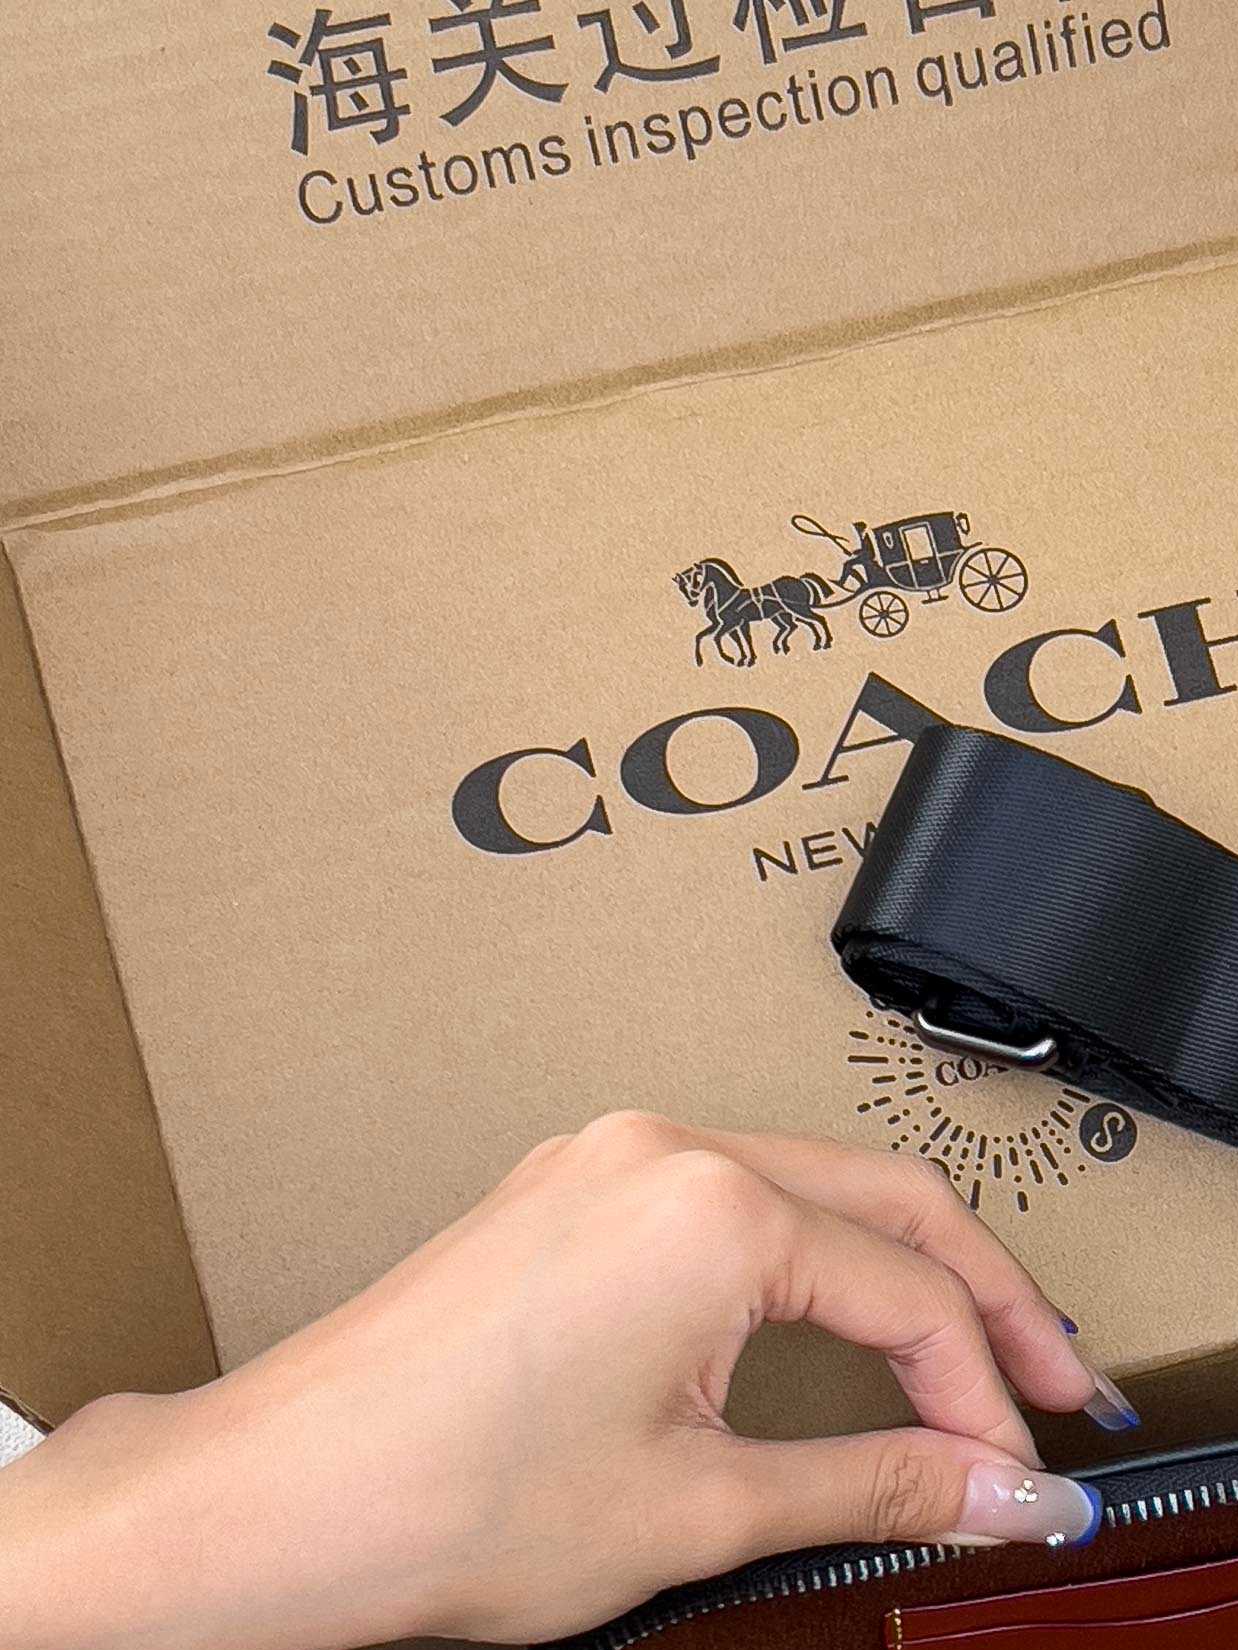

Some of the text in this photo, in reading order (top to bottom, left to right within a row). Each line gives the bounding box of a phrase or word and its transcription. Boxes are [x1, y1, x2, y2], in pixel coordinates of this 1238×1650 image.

[297, 0, 1171, 226] Customs inspection qualified
